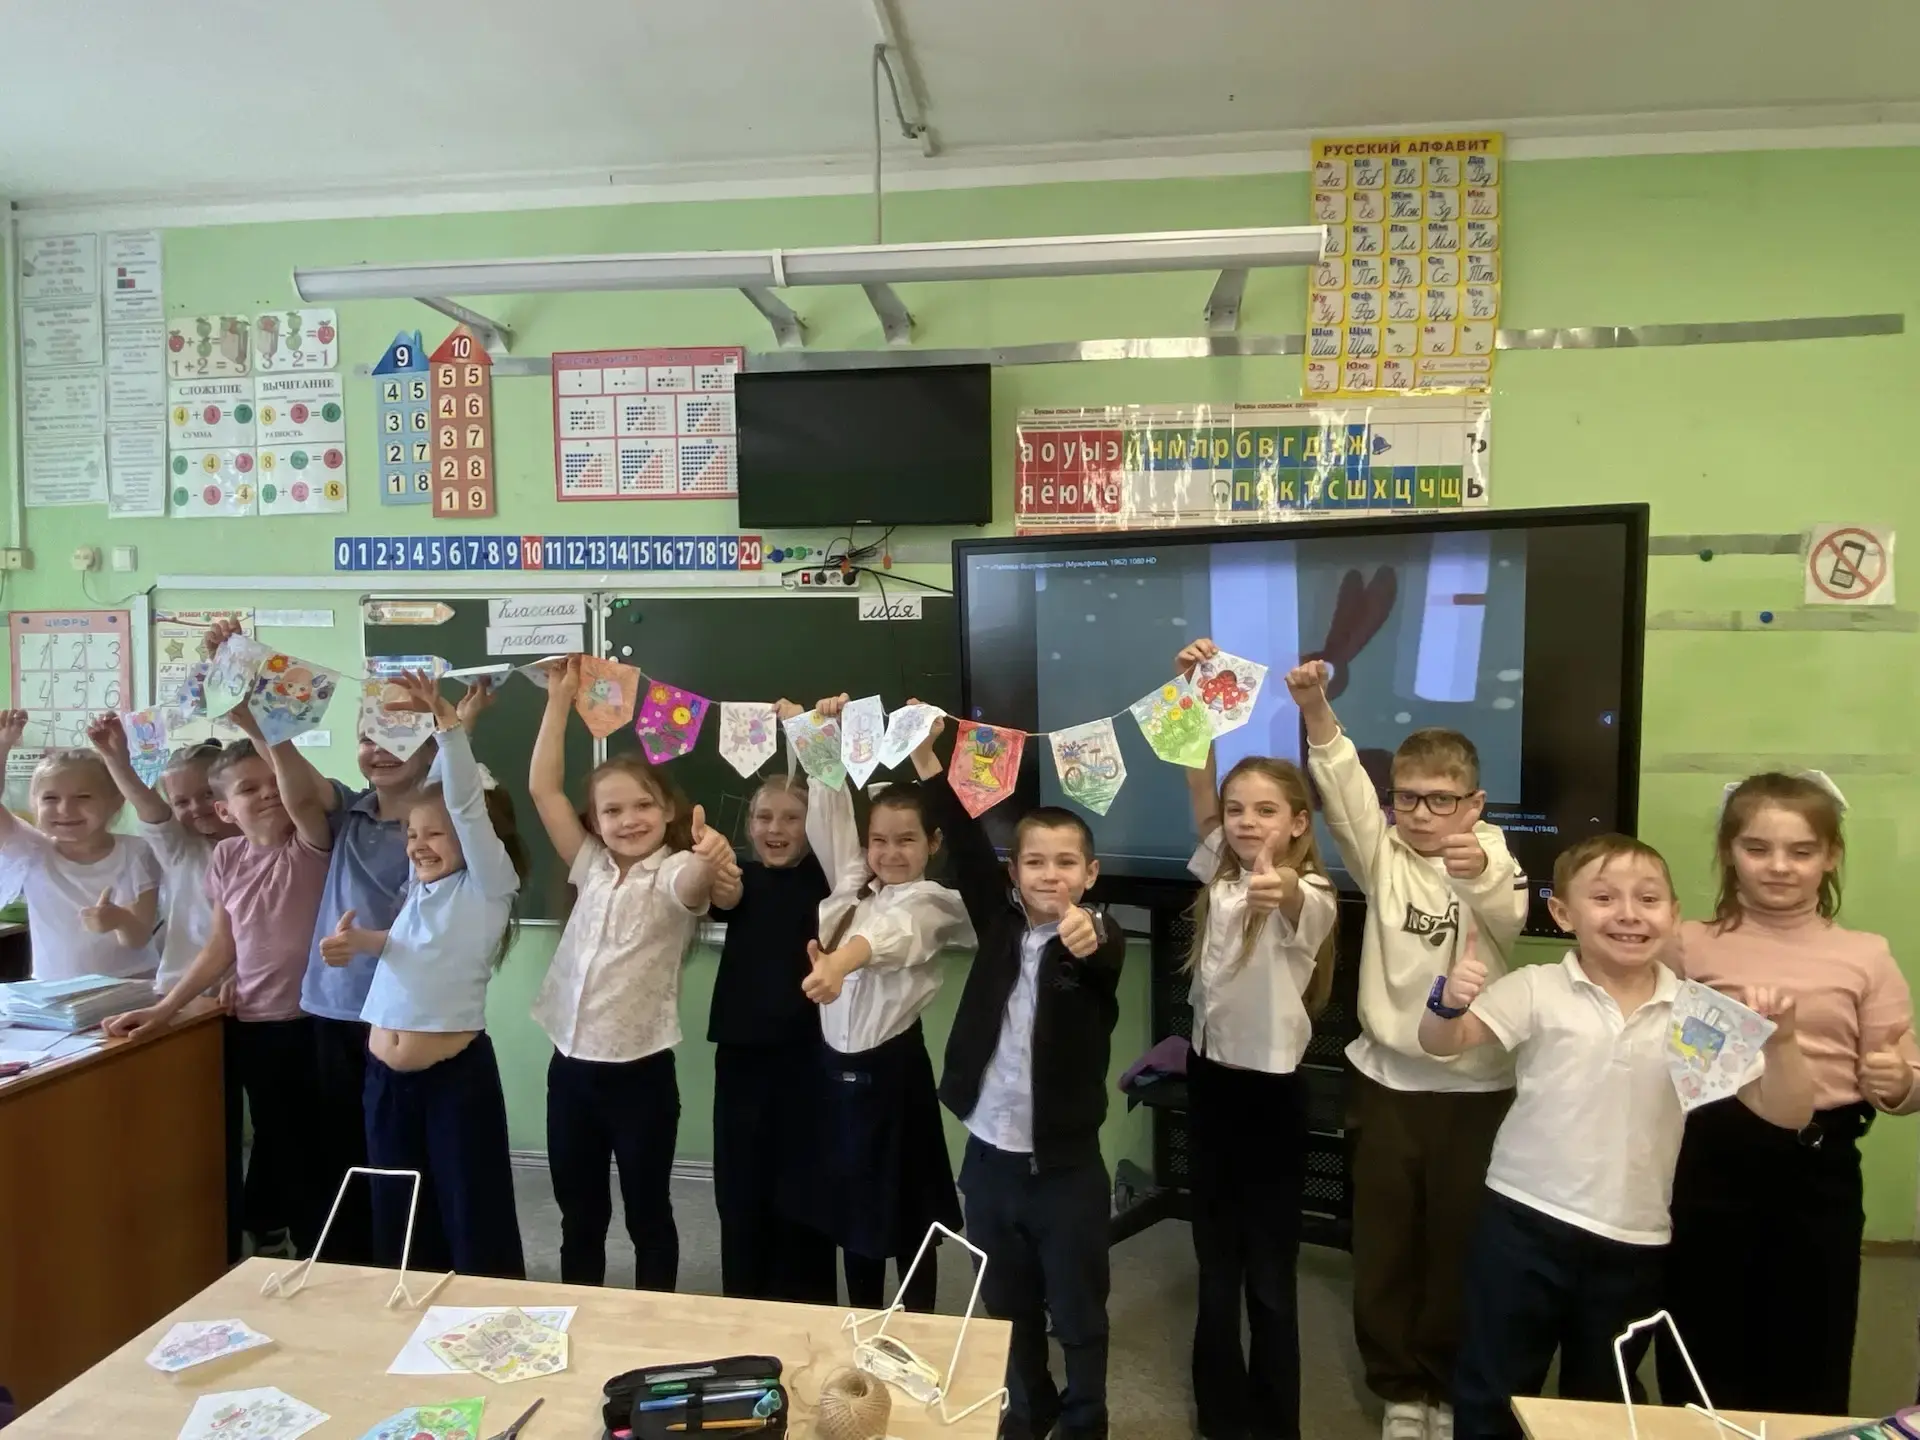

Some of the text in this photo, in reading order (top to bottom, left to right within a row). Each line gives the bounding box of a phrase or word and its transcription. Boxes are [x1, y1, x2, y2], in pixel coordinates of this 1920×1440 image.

[1324, 139, 1491, 157] РУССКИЙ АЛФАВИТ
[1318, 172, 1340, 187] Аа
[1357, 169, 1382, 186] Бб
[1394, 168, 1414, 185] Вв
[1391, 201, 1420, 218] Жж
[1357, 236, 1376, 251] Кк
[1392, 235, 1416, 249] Лл
[1428, 235, 1457, 249] Мм
[1319, 270, 1337, 286] Оо
[1353, 268, 1379, 284] Пп
[1432, 267, 1452, 282] Сс
[1390, 301, 1416, 318] Хх
[1428, 300, 1452, 321] Цц
[452, 337, 471, 358] 10
[1312, 339, 1337, 355] Шш
[1348, 338, 1377, 358] Щщ
[262, 350, 329, 369] 3 2 1
[396, 347, 409, 366] 9
[172, 360, 179, 376] 1
[197, 358, 208, 374] 2
[263, 379, 334, 391] ВЫЧИТАНИЕ
[443, 368, 478, 385] 5 5
[179, 384, 242, 395] СЛОЖЕНИЕ
[388, 382, 424, 400] 4 5
[265, 410, 272, 421] 8
[442, 399, 479, 415] 4 6
[389, 414, 426, 431] 3 6
[444, 430, 479, 446] 3 7
[391, 444, 426, 461] 2 7
[1020, 447, 1033, 462] а
[1041, 447, 1055, 462] о
[1063, 441, 1077, 469] у
[1082, 442, 1100, 461] ы
[1106, 440, 1119, 462] э
[1149, 440, 1162, 459] н
[1168, 440, 1186, 459] м
[1192, 439, 1207, 458] л
[1213, 438, 1229, 465] р
[1236, 431, 1251, 458] б
[1259, 437, 1273, 457] в
[1283, 437, 1294, 456] г
[1303, 435, 1320, 461] д
[1349, 435, 1367, 455] ж
[1467, 433, 1487, 454] ъ
[265, 456, 272, 468] 8
[444, 460, 481, 478] 2 8
[330, 484, 338, 496] 8
[392, 475, 428, 492] 1 8
[1021, 488, 1033, 504] я
[1041, 478, 1054, 504] ё
[1060, 486, 1078, 504] ю
[1084, 484, 1097, 504] и
[1105, 484, 1118, 504] е
[1235, 481, 1249, 501] п
[1281, 481, 1294, 500] к
[1328, 480, 1339, 500] с
[1347, 479, 1366, 499] ш
[1374, 479, 1387, 499] х
[1395, 479, 1411, 504] ц
[1420, 478, 1433, 498] ч
[1441, 478, 1461, 504] щ
[1467, 478, 1483, 498] ь
[445, 491, 482, 508] 1 9
[339, 542, 760, 565] 0 1 2 3 4 5 6 7 8 9 10 11 12 13 14 15 16 17 18 19 20
[1145, 557, 1157, 565] HD
[498, 597, 577, 621] Классная
[44, 617, 90, 627] ЦИФРЫ
[21, 634, 93, 644] 1 2 3
[501, 627, 568, 653] работа
[40, 641, 120, 670] 1 2 3
[21, 674, 95, 683] 4 5 6
[39, 680, 121, 709] 4 5 6
[55, 713, 61, 721] 8
[71, 720, 85, 747] 8
